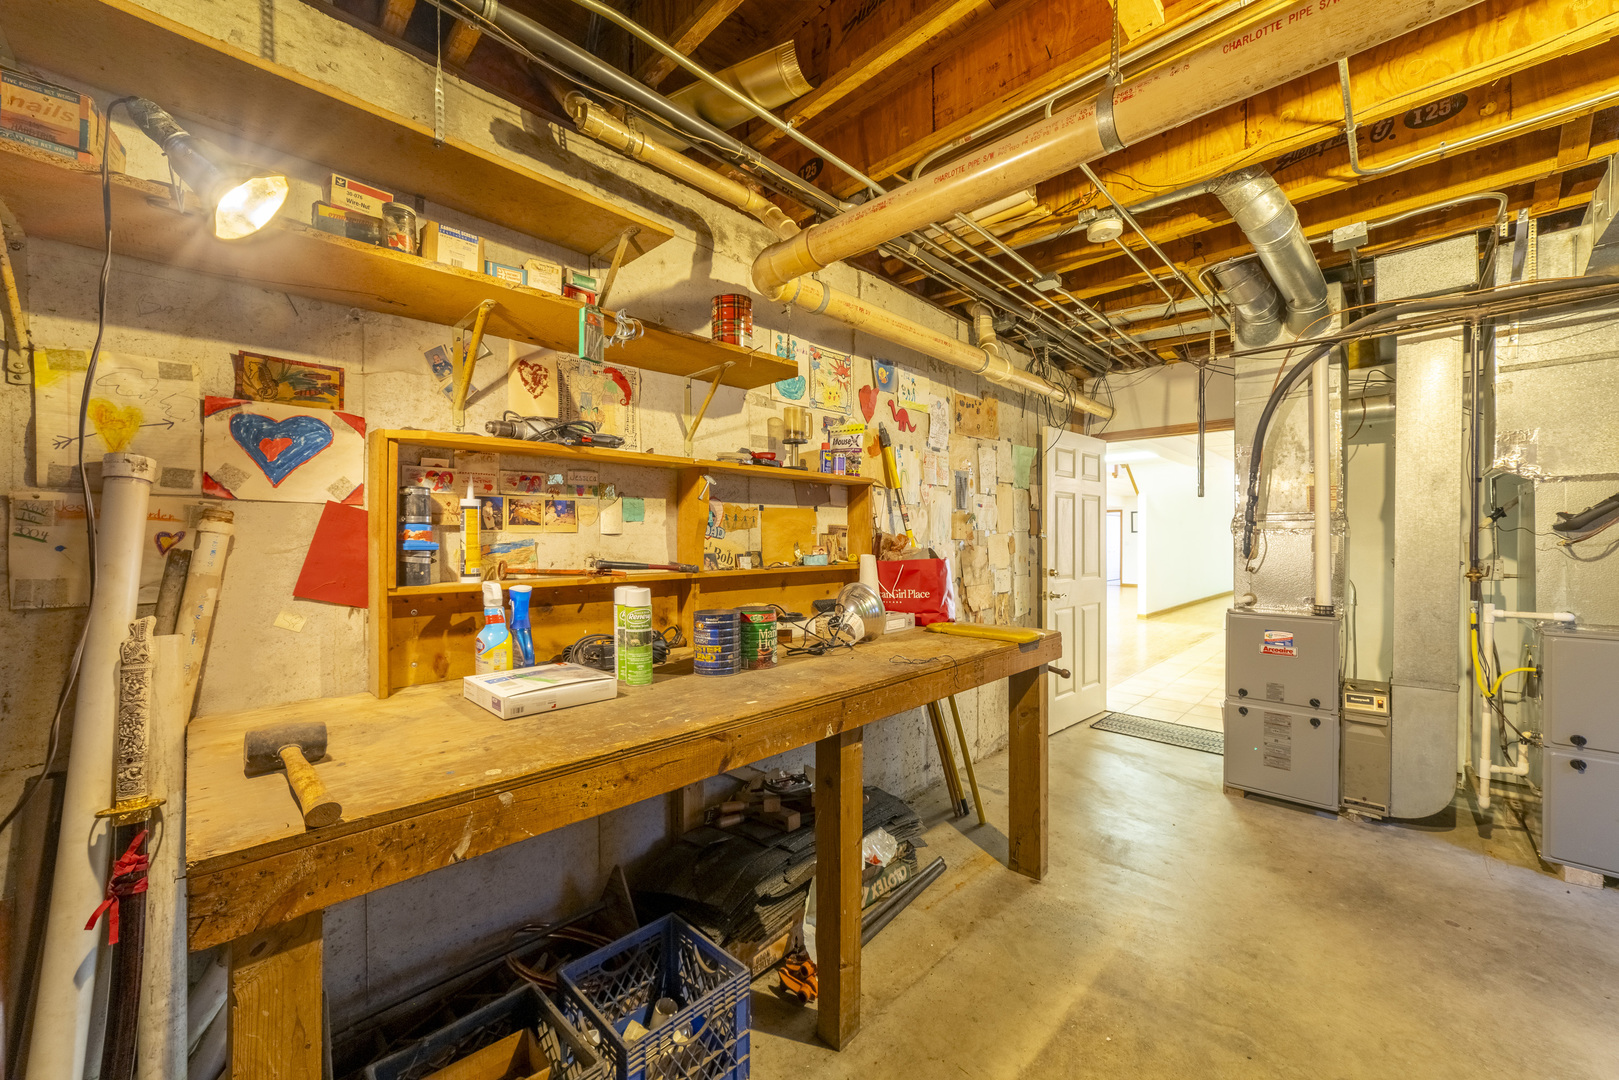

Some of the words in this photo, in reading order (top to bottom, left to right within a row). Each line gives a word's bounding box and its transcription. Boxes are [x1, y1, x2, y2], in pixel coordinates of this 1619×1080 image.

[1222, 18, 1283, 54] CHARLOTTE
[1288, 5, 1313, 25] PIPE
[8, 95, 75, 122] nails
[1077, 111, 1094, 122] ASTM
[933, 164, 965, 185] CHARLOTTE
[967, 157, 981, 169] PIPE
[345, 197, 371, 210] Wire-Nut
[714, 546, 734, 565] Bob
[892, 588, 907, 599] Girl
[907, 588, 931, 599] Place
